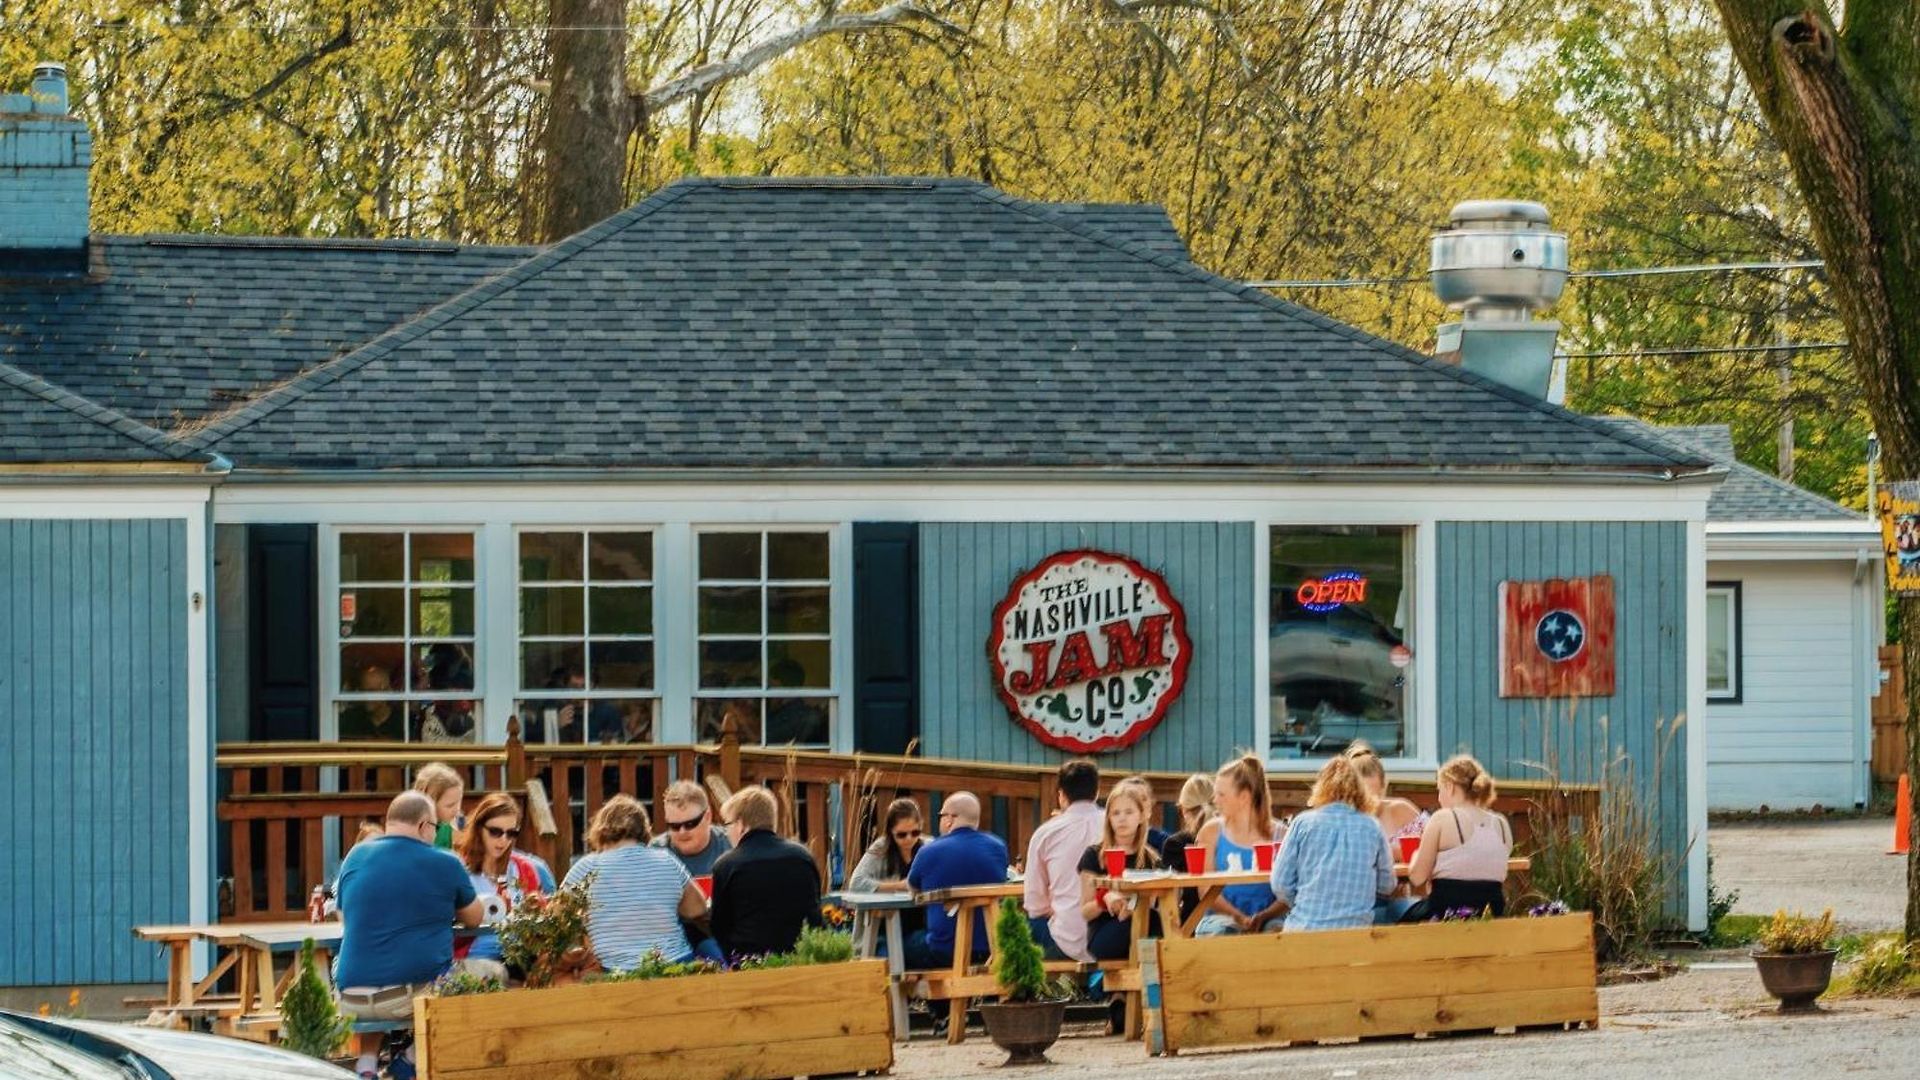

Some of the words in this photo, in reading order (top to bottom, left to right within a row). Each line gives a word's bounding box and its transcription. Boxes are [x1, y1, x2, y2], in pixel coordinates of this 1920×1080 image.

[1014, 580, 1143, 640] NASHVILLE
[1040, 577, 1089, 602] THE
[1297, 577, 1367, 603] OPEN
[1009, 613, 1173, 695] JAM
